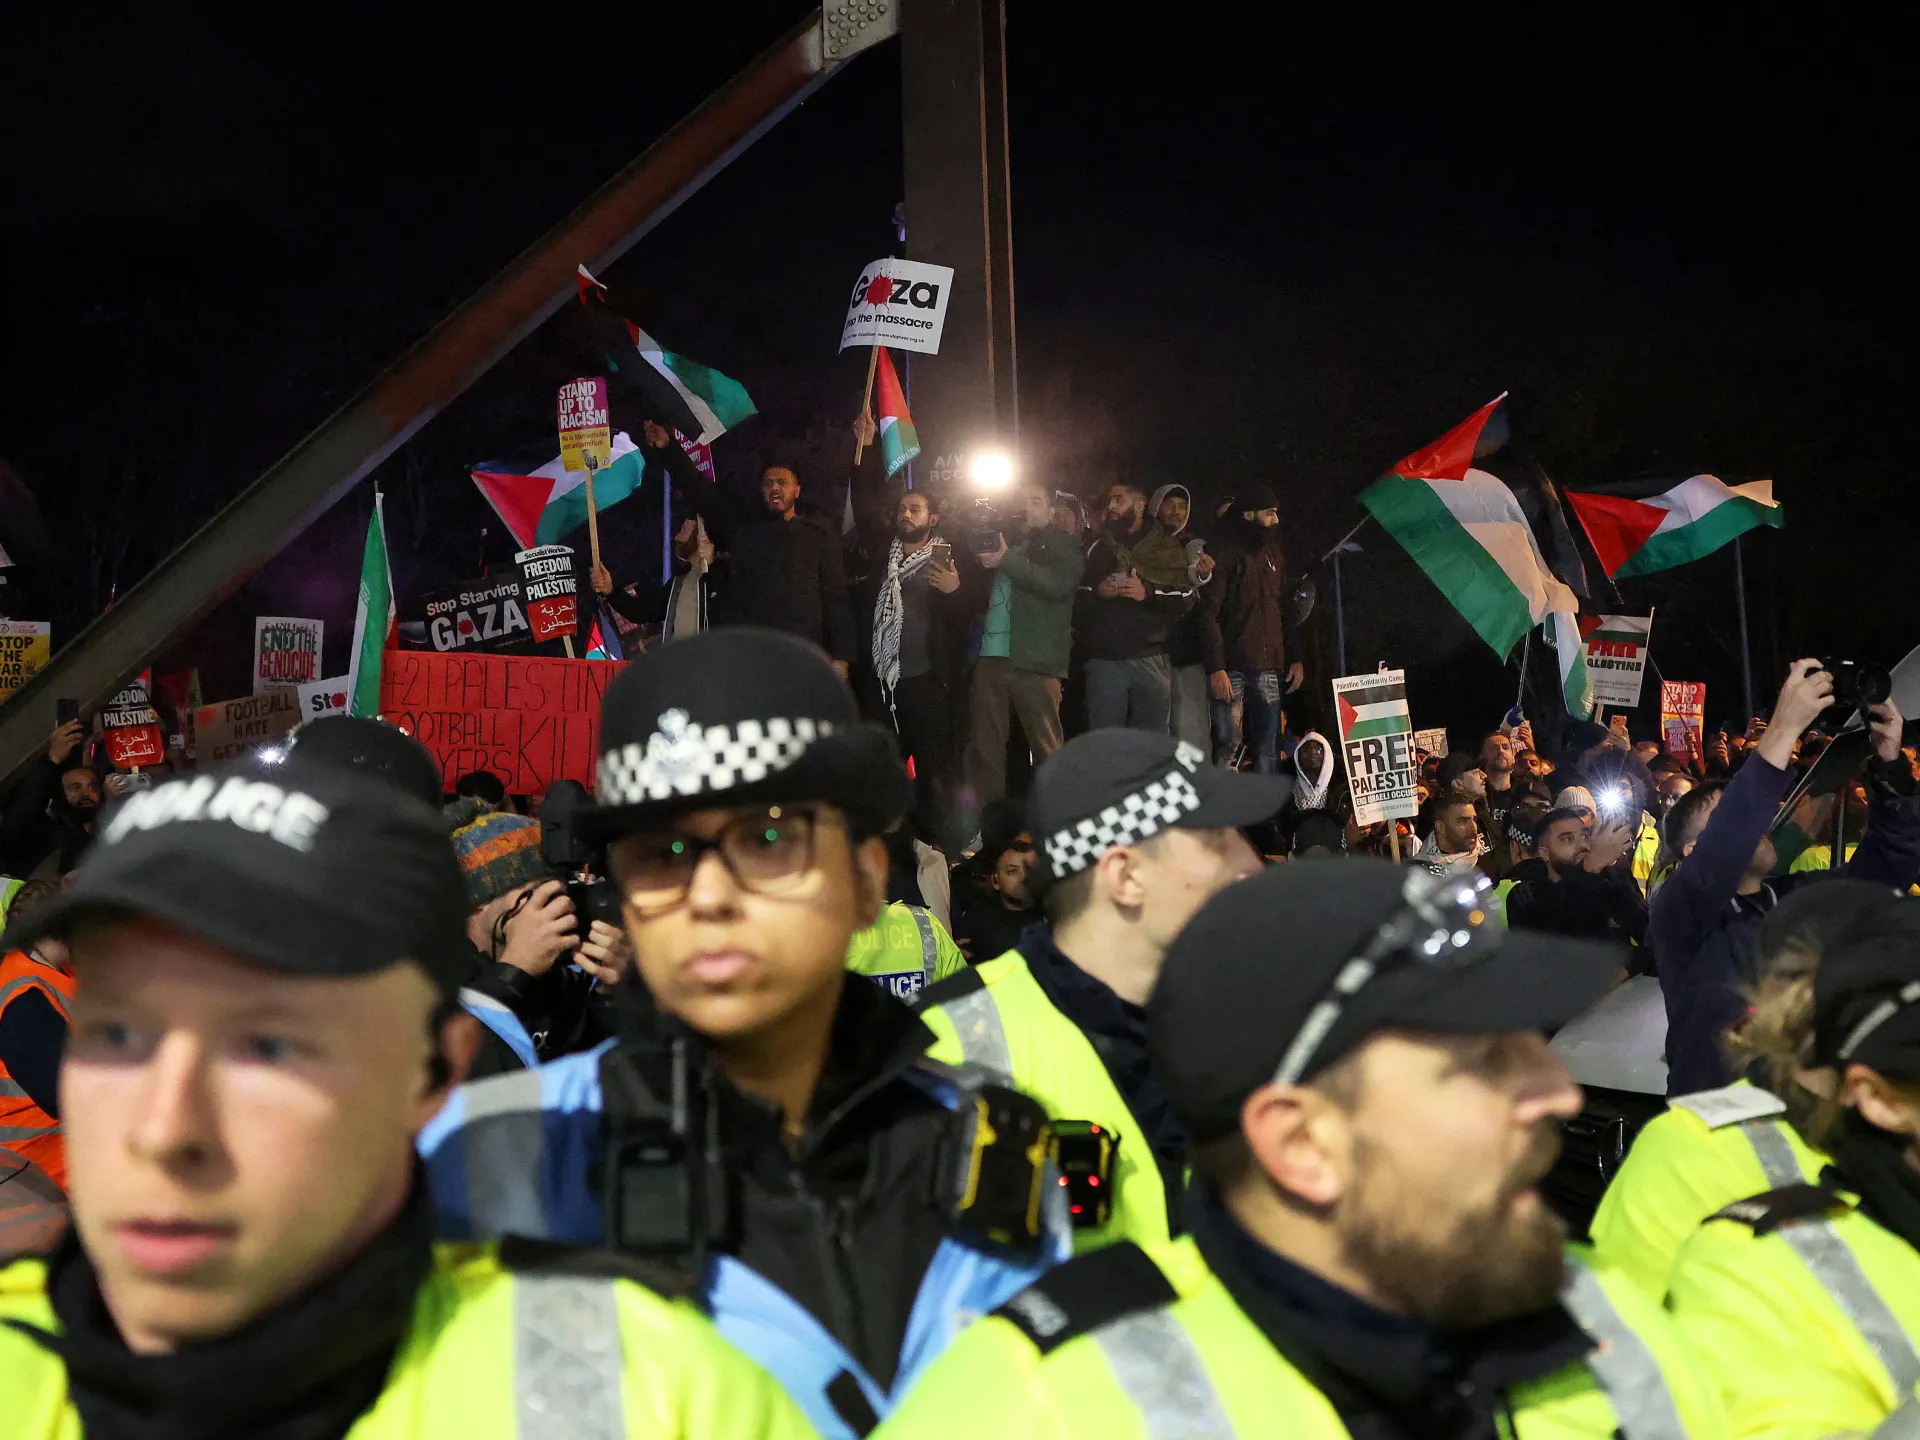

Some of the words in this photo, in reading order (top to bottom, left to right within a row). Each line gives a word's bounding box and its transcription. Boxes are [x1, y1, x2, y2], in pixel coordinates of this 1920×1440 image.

[852, 276, 939, 310] Gza
[858, 313, 872, 324] the
[875, 314, 933, 330] massacre
[559, 381, 597, 400] STAND
[559, 399, 574, 415] UP
[577, 396, 594, 411] TO
[560, 409, 607, 429] RACISM
[524, 556, 572, 579] FREEDOM
[427, 599, 457, 616] Stop
[460, 583, 519, 606] Starving
[431, 599, 528, 652] GAZA
[260, 629, 295, 651] END
[295, 631, 317, 653] THE
[1588, 639, 1638, 658] FREE
[0, 663, 21, 676] AR
[259, 650, 317, 681] GENOCIDE
[1337, 681, 1359, 690] Palestine
[1360, 677, 1388, 686] Solidarity
[1664, 683, 1697, 694] STAND
[109, 688, 147, 706] EEDOM
[312, 691, 348, 713] St
[1664, 693, 1678, 703] UP
[1680, 693, 1693, 704] TO
[226, 693, 293, 723] FOOTBALL
[1664, 703, 1702, 714] RACISM
[104, 709, 155, 728] PALESTINE
[115, 730, 149, 746] الحرية
[234, 720, 270, 741] HATE
[114, 743, 156, 762] لفلسطين
[1345, 733, 1416, 778] FREE
[436, 749, 512, 789] YERS
[1368, 791, 1390, 804] ISRAELI
